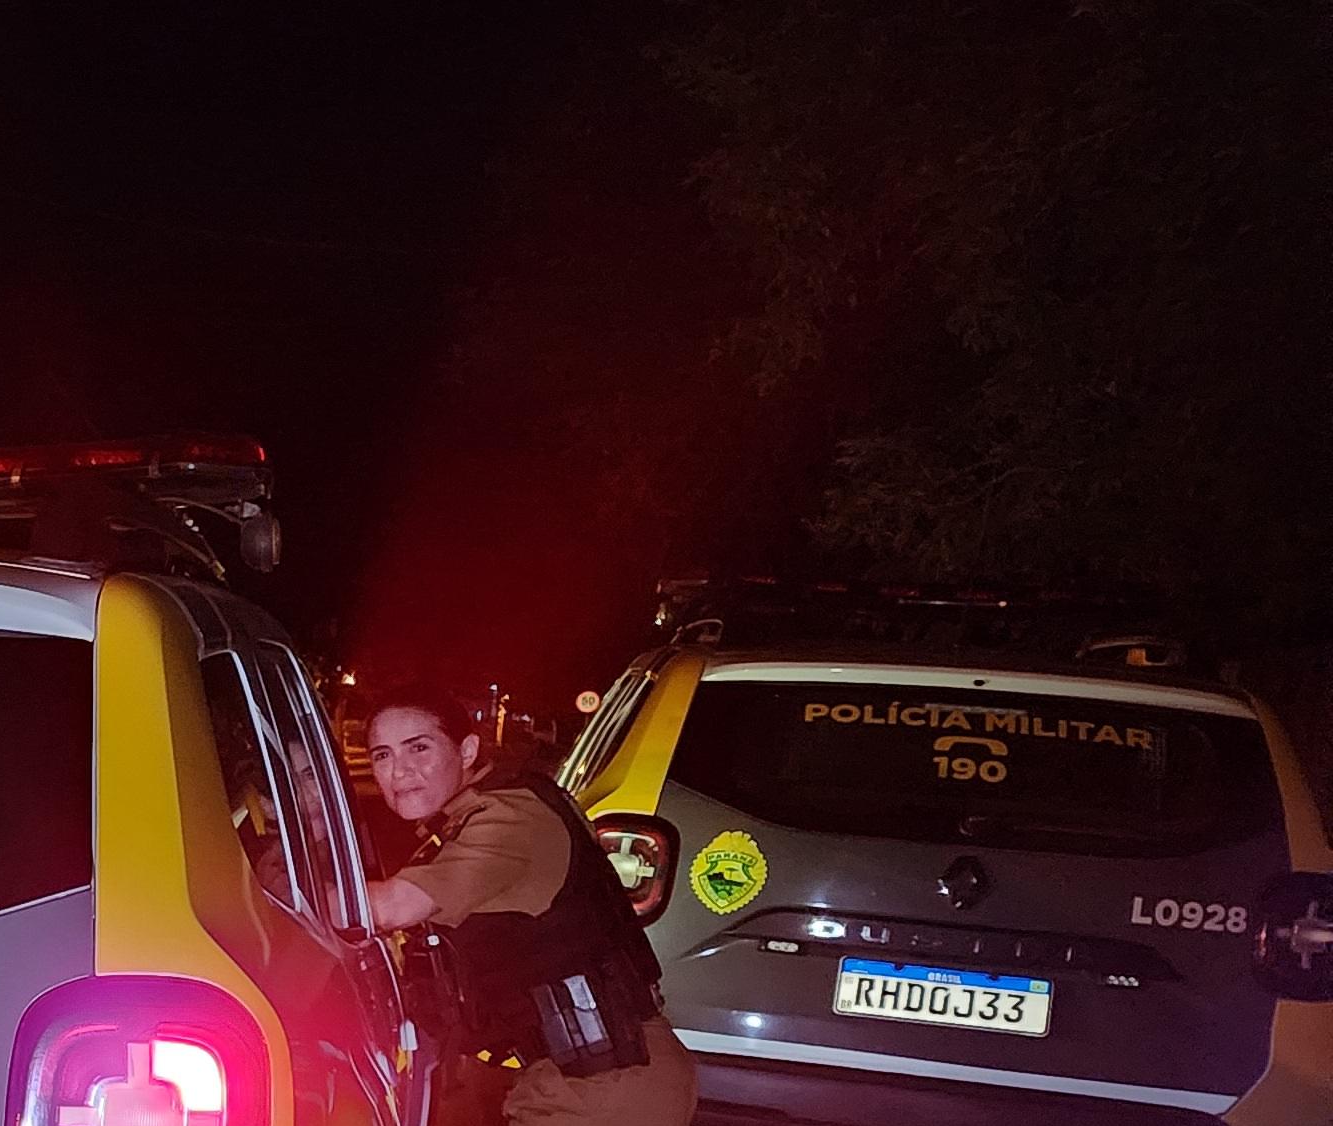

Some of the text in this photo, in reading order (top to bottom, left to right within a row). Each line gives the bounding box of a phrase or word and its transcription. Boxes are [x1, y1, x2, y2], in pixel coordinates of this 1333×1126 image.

[804, 702, 1153, 750] POLÍCIA MILITAR
[933, 756, 1007, 783] 190
[1131, 896, 1247, 933] L0928
